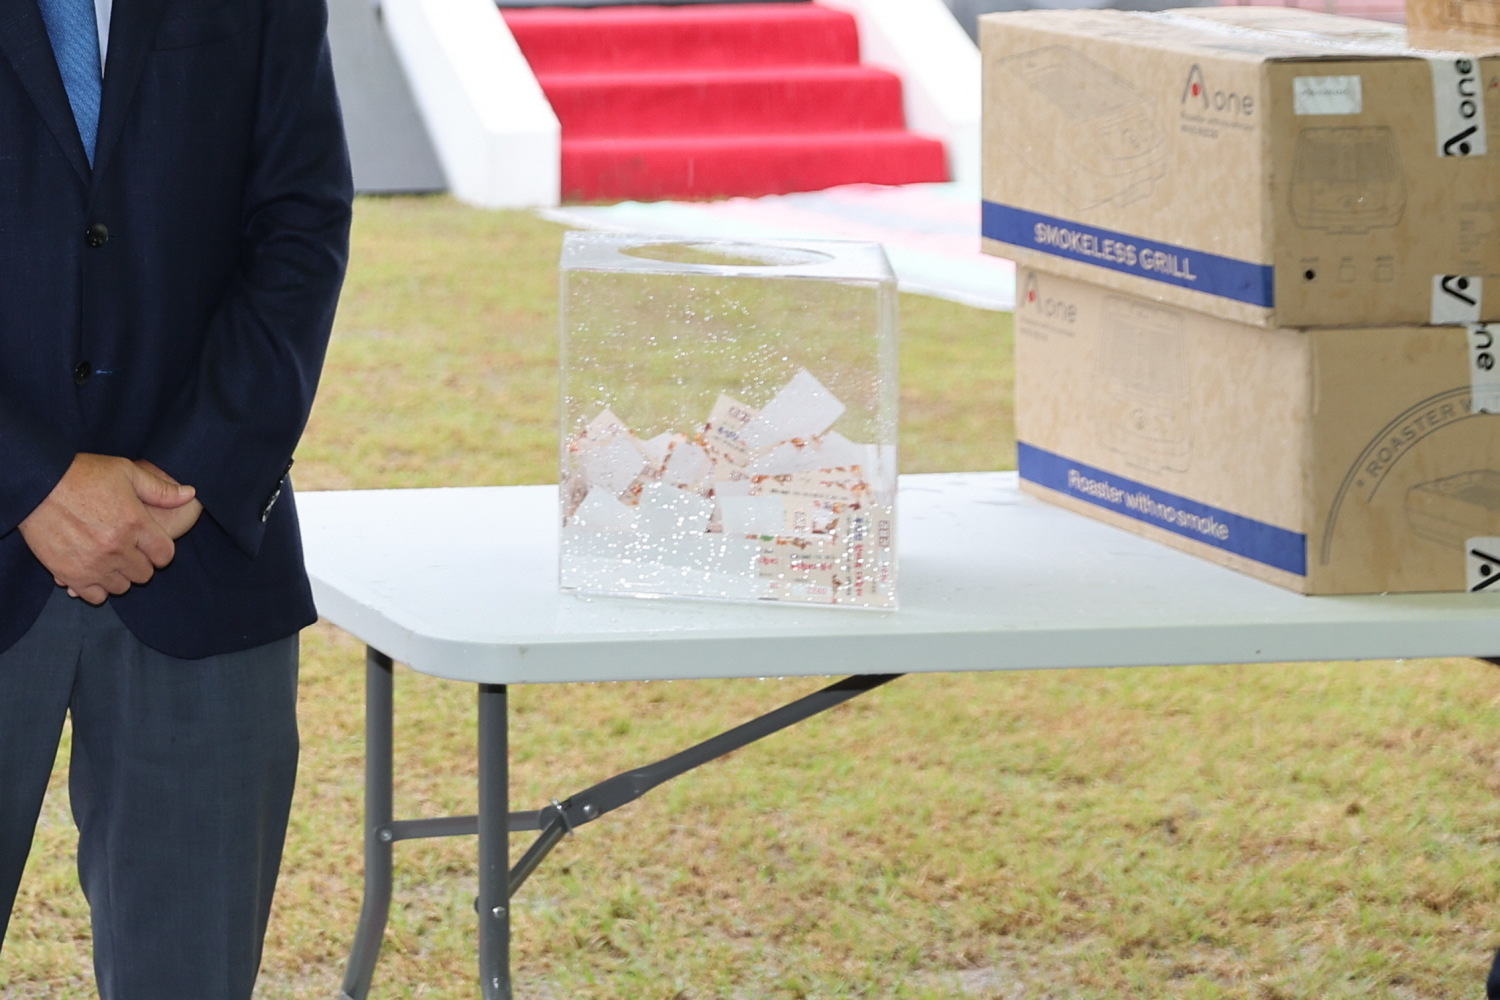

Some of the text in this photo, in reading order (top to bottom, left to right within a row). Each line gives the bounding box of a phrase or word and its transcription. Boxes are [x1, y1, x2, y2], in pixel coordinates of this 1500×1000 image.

[1033, 222, 1198, 282] SMOKELESS GRILL
[1365, 402, 1457, 478] ROASTER
[1067, 468, 1229, 541] Roaster with no smoke
